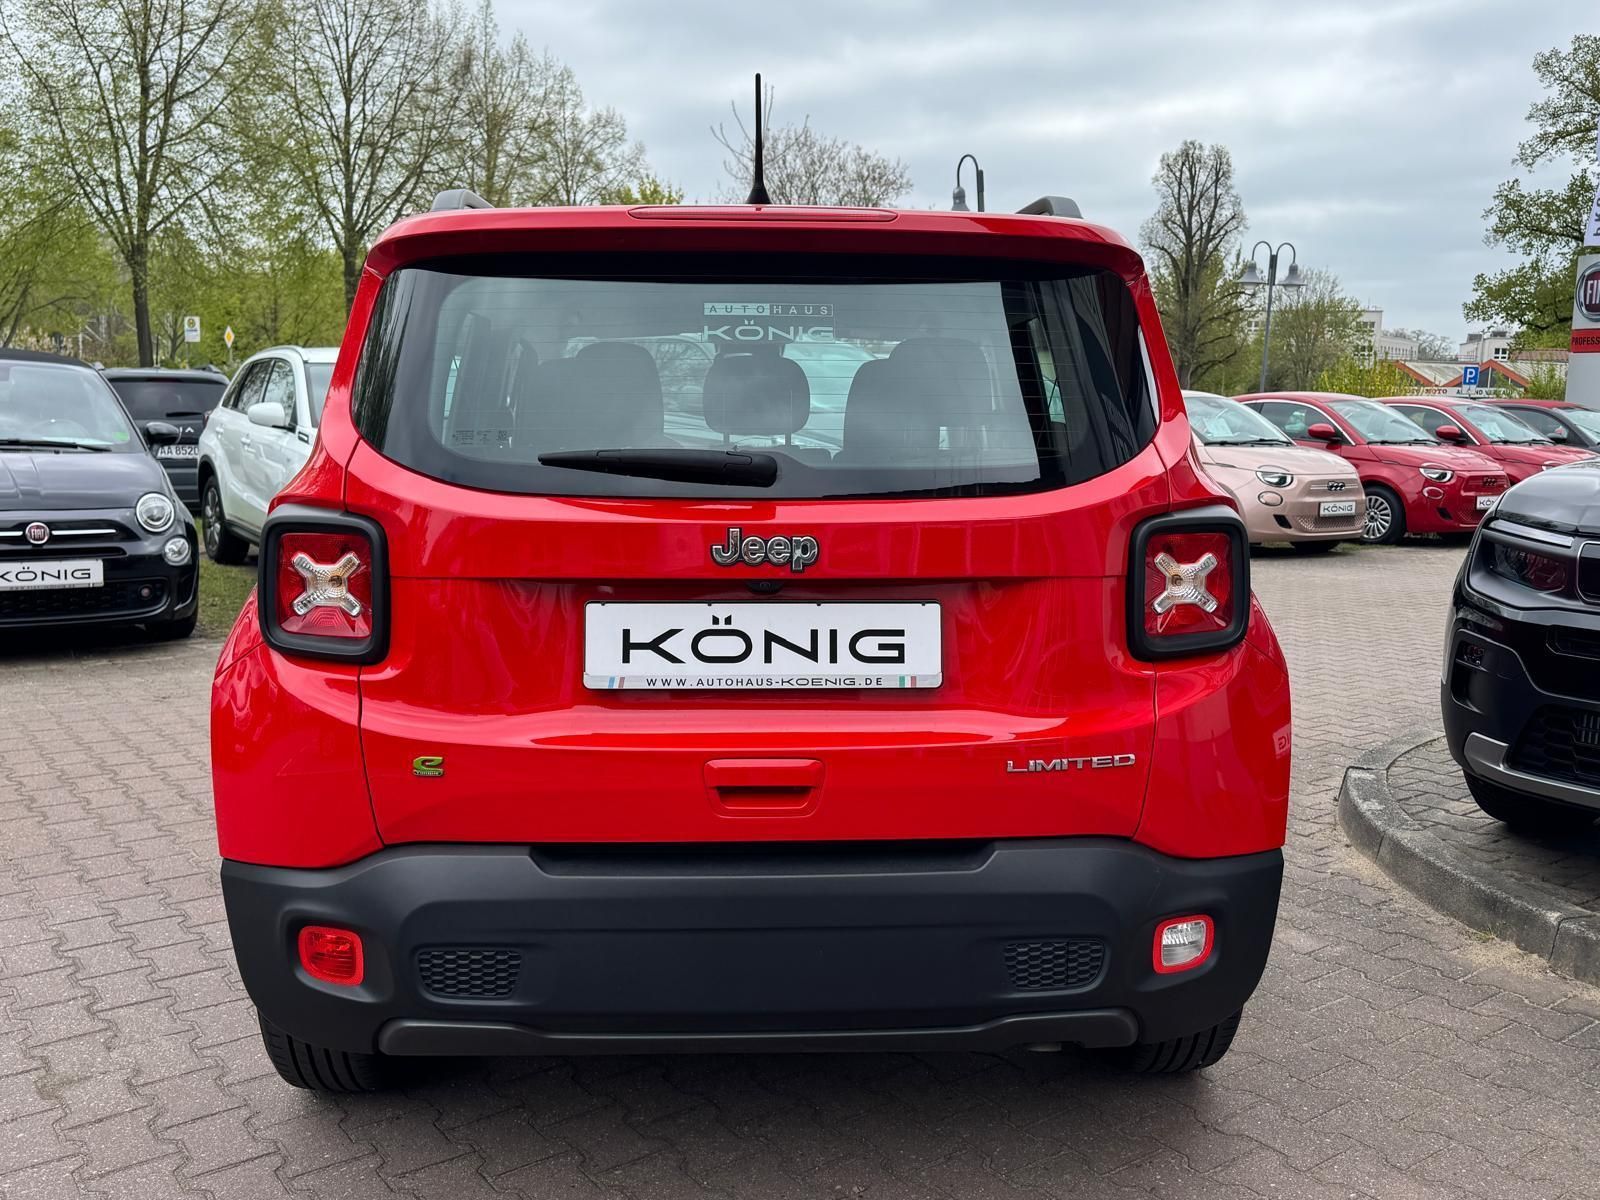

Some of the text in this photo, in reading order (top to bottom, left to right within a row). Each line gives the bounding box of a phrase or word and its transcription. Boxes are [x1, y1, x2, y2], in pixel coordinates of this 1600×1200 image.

[709, 304, 828, 315] AUTOHAUS
[702, 319, 834, 342] KÖNIG
[1466, 368, 1476, 383] P
[1323, 503, 1353, 513] KÖNIG
[711, 527, 819, 572] Jeep
[622, 614, 906, 664] KÖNIG
[646, 676, 883, 687] WWW.AUTOHAUS-KOENIG.DE
[1007, 753, 1136, 773] LIMITED
